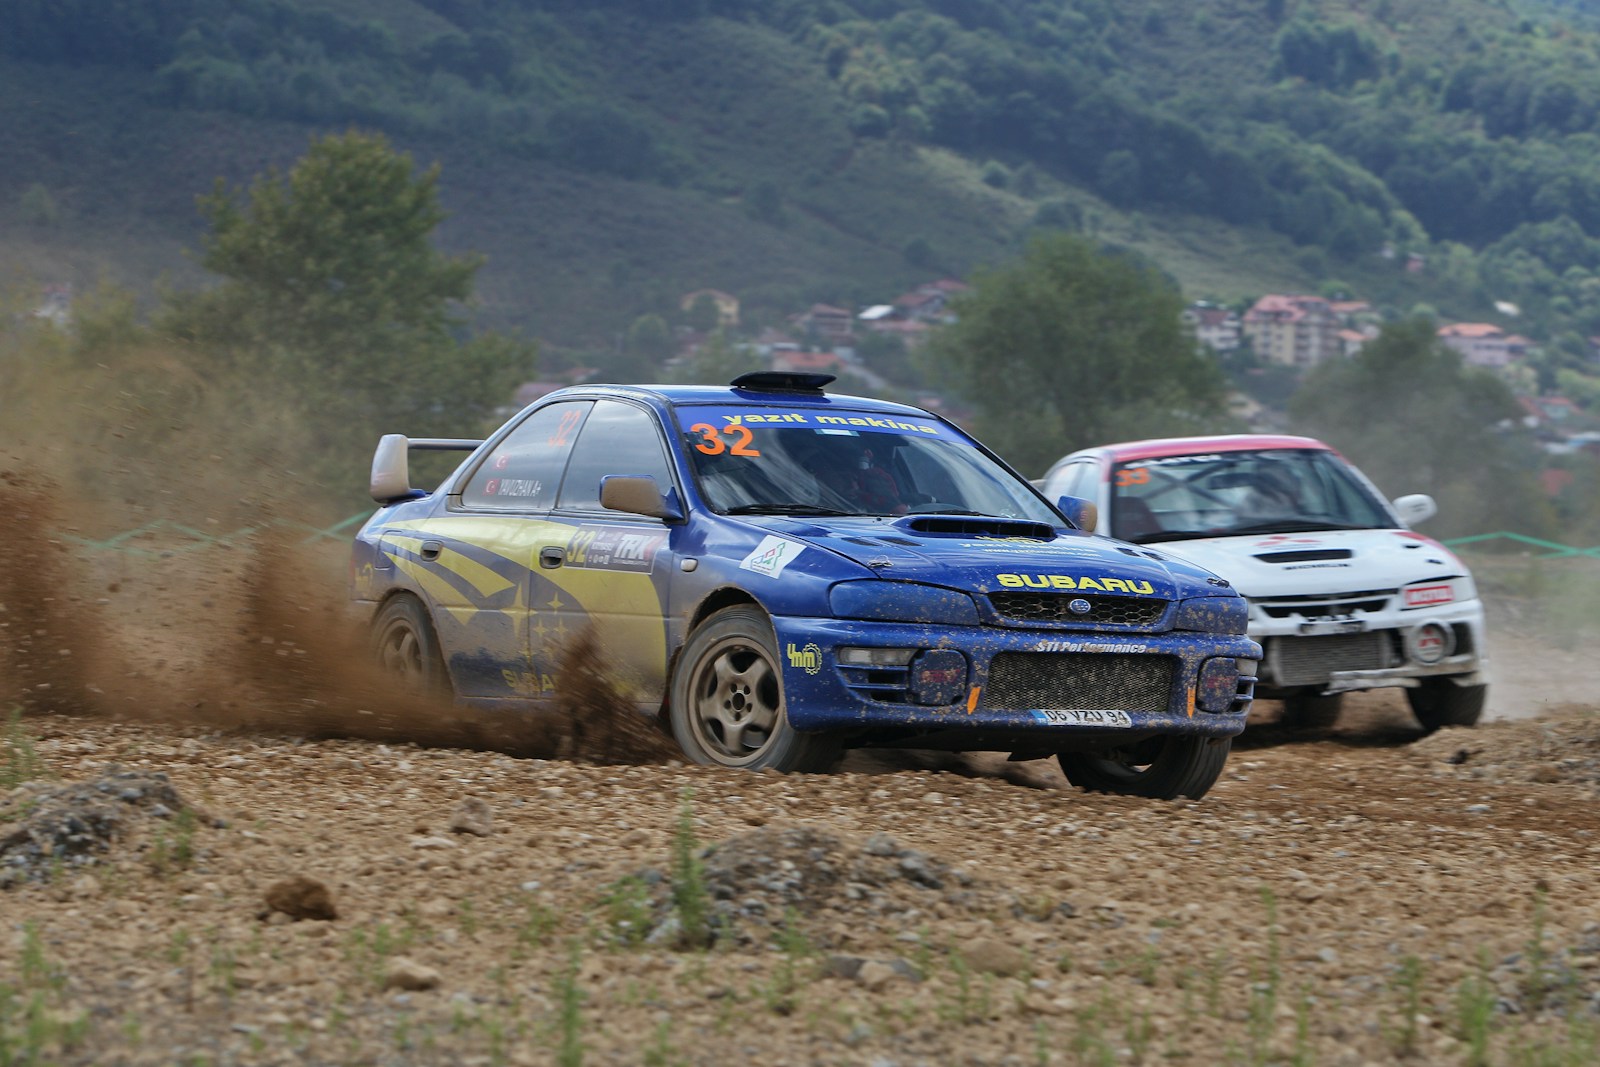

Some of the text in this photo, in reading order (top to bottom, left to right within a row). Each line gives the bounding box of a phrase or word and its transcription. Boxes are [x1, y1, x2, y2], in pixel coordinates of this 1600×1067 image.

[815, 415, 939, 435] makina
[690, 423, 761, 457] 32
[997, 573, 1155, 595] SUBARU
[1059, 641, 1147, 654] Performance
[1068, 710, 1104, 722] VZU
